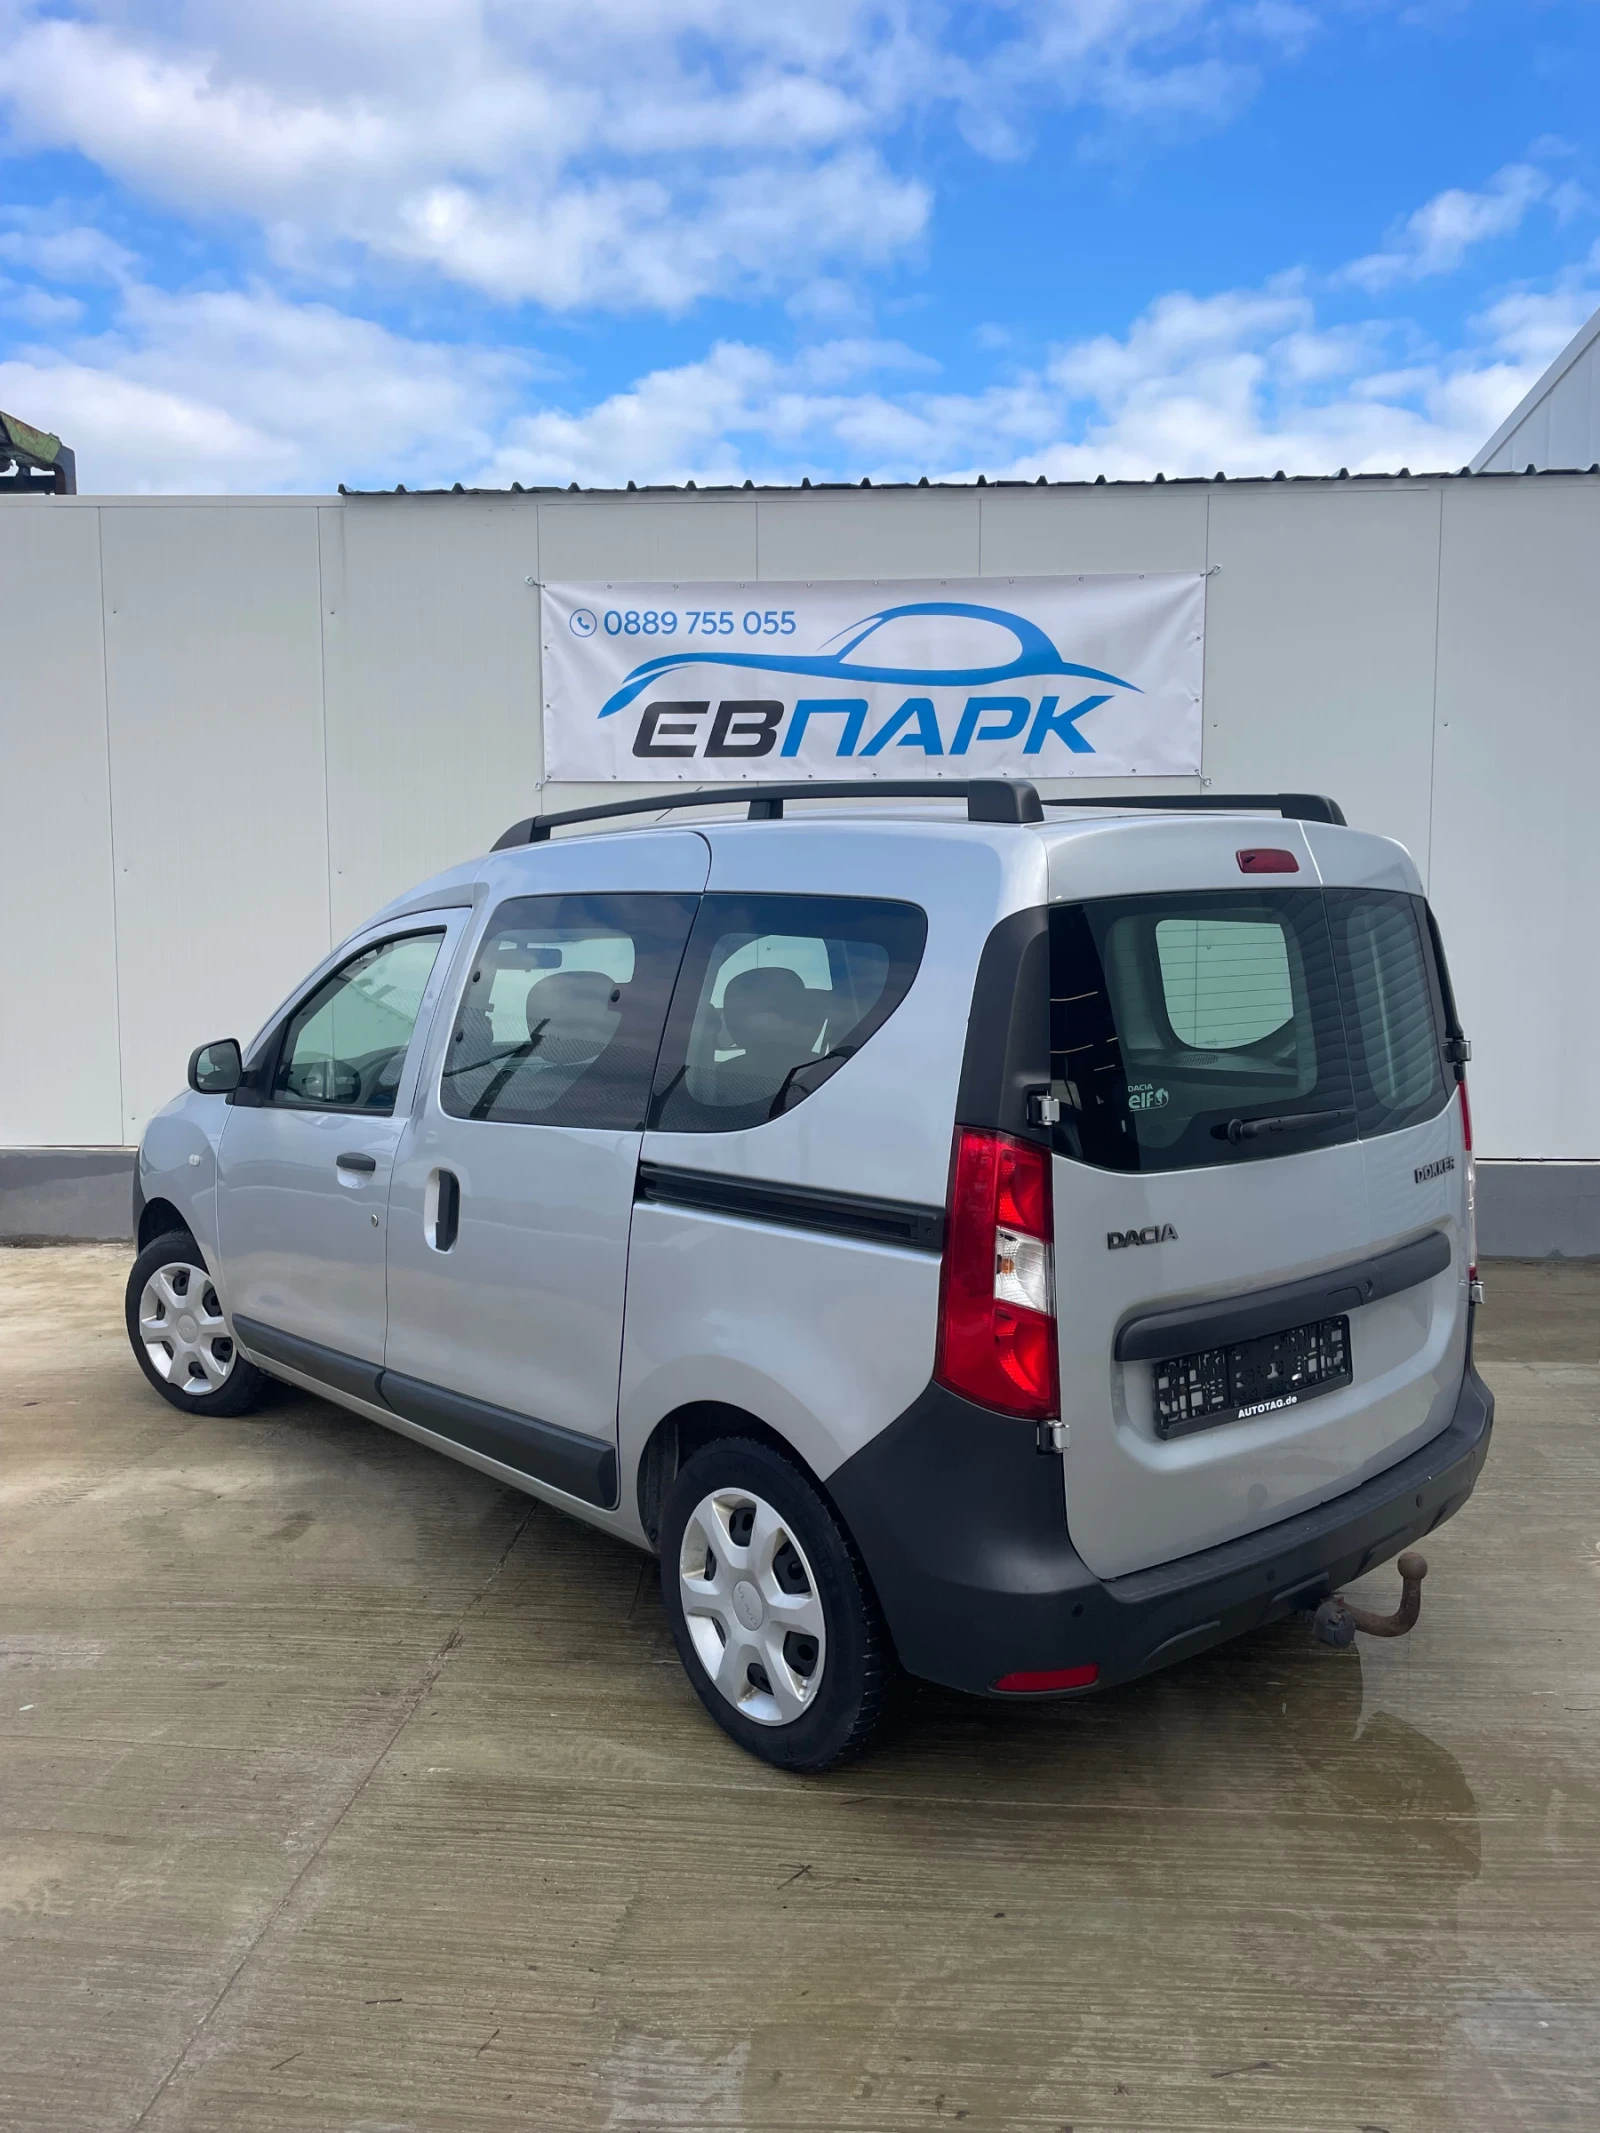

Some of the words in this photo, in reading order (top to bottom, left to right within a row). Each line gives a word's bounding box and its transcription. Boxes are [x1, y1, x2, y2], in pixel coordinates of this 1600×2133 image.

[603, 610, 678, 636] 0889
[685, 611, 735, 635] 755
[742, 610, 797, 635] 055
[632, 694, 1115, 758] ЕВПАРК
[1127, 1083, 1154, 1093] DACIA
[1128, 1091, 1154, 1109] elf
[1414, 1155, 1455, 1184] DOKKER
[1107, 1223, 1179, 1250] DACIA
[1238, 1395, 1298, 1419] AUTOTAG.de
